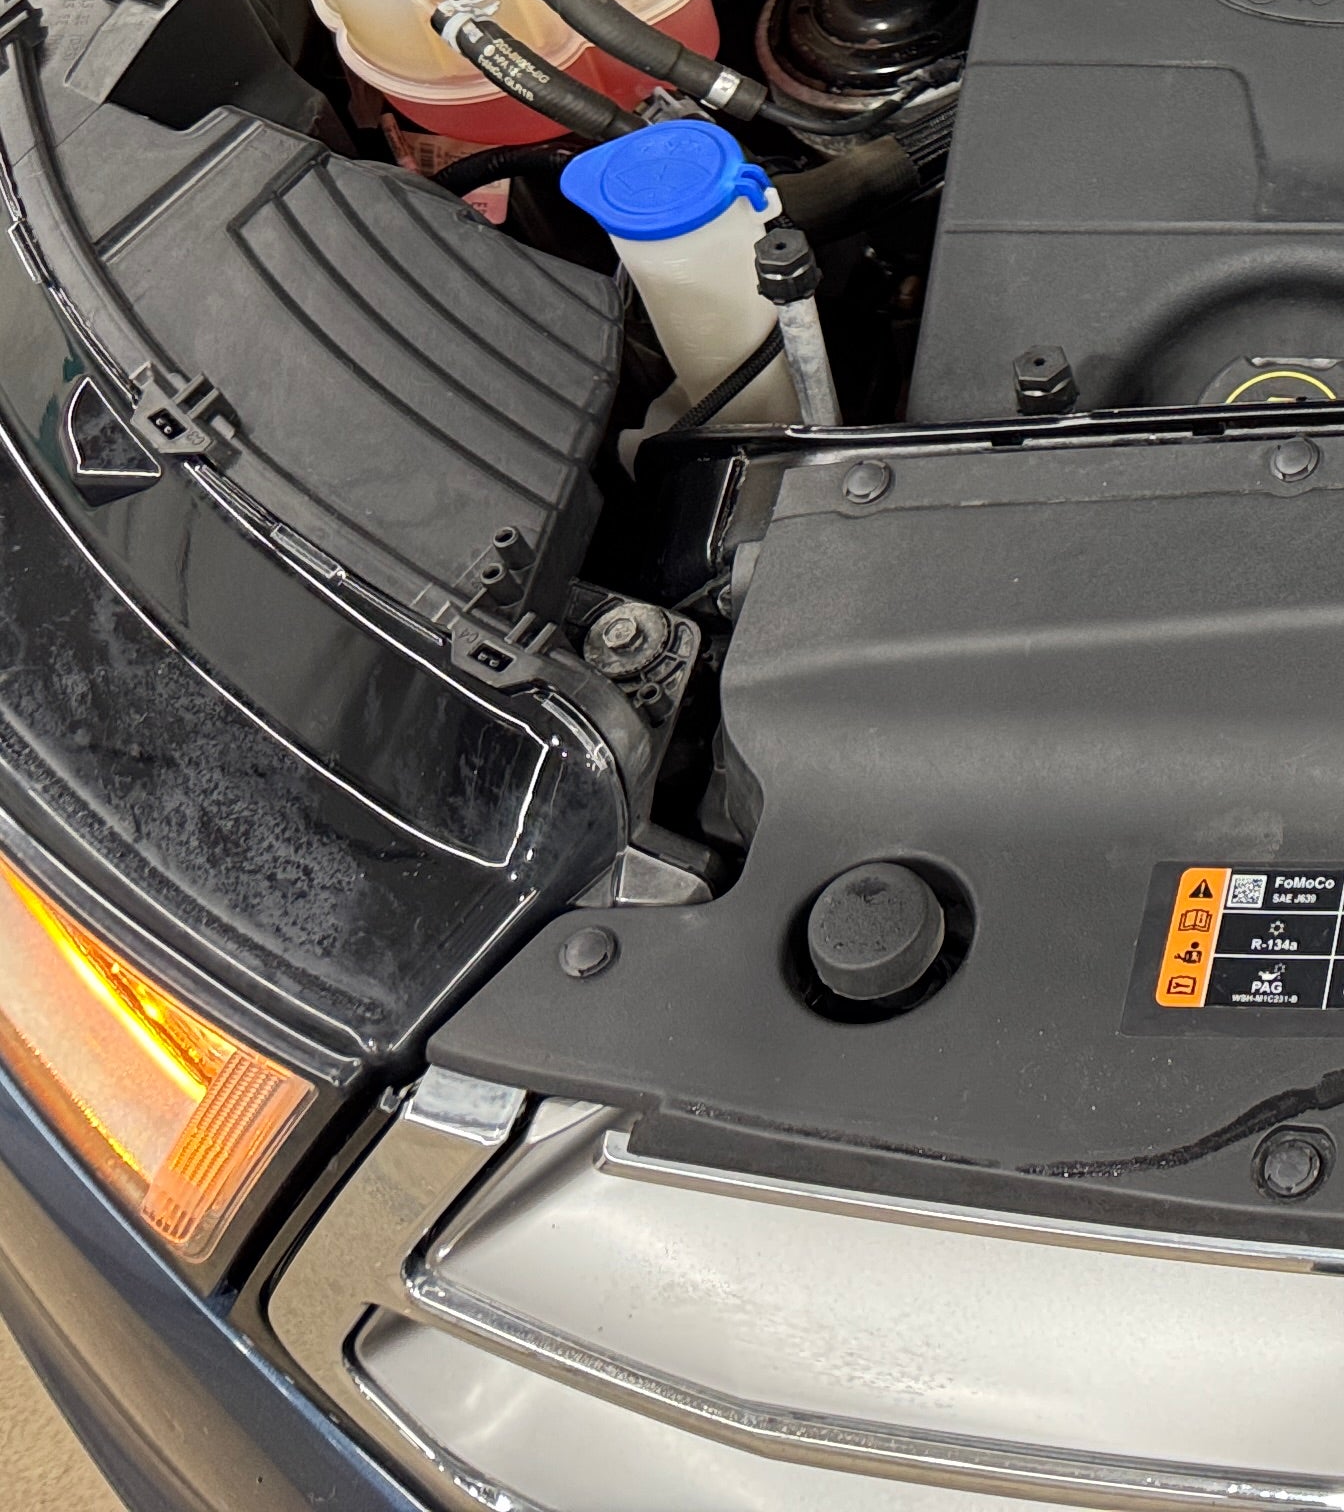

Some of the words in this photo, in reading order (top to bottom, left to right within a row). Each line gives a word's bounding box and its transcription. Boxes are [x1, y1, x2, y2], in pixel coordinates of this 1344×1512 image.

[1274, 876, 1335, 889] FoMoCo
[1272, 893, 1293, 903] SAE
[1293, 893, 1317, 904] J639
[1250, 938, 1298, 952] R-134a
[1250, 981, 1283, 994] PAG
